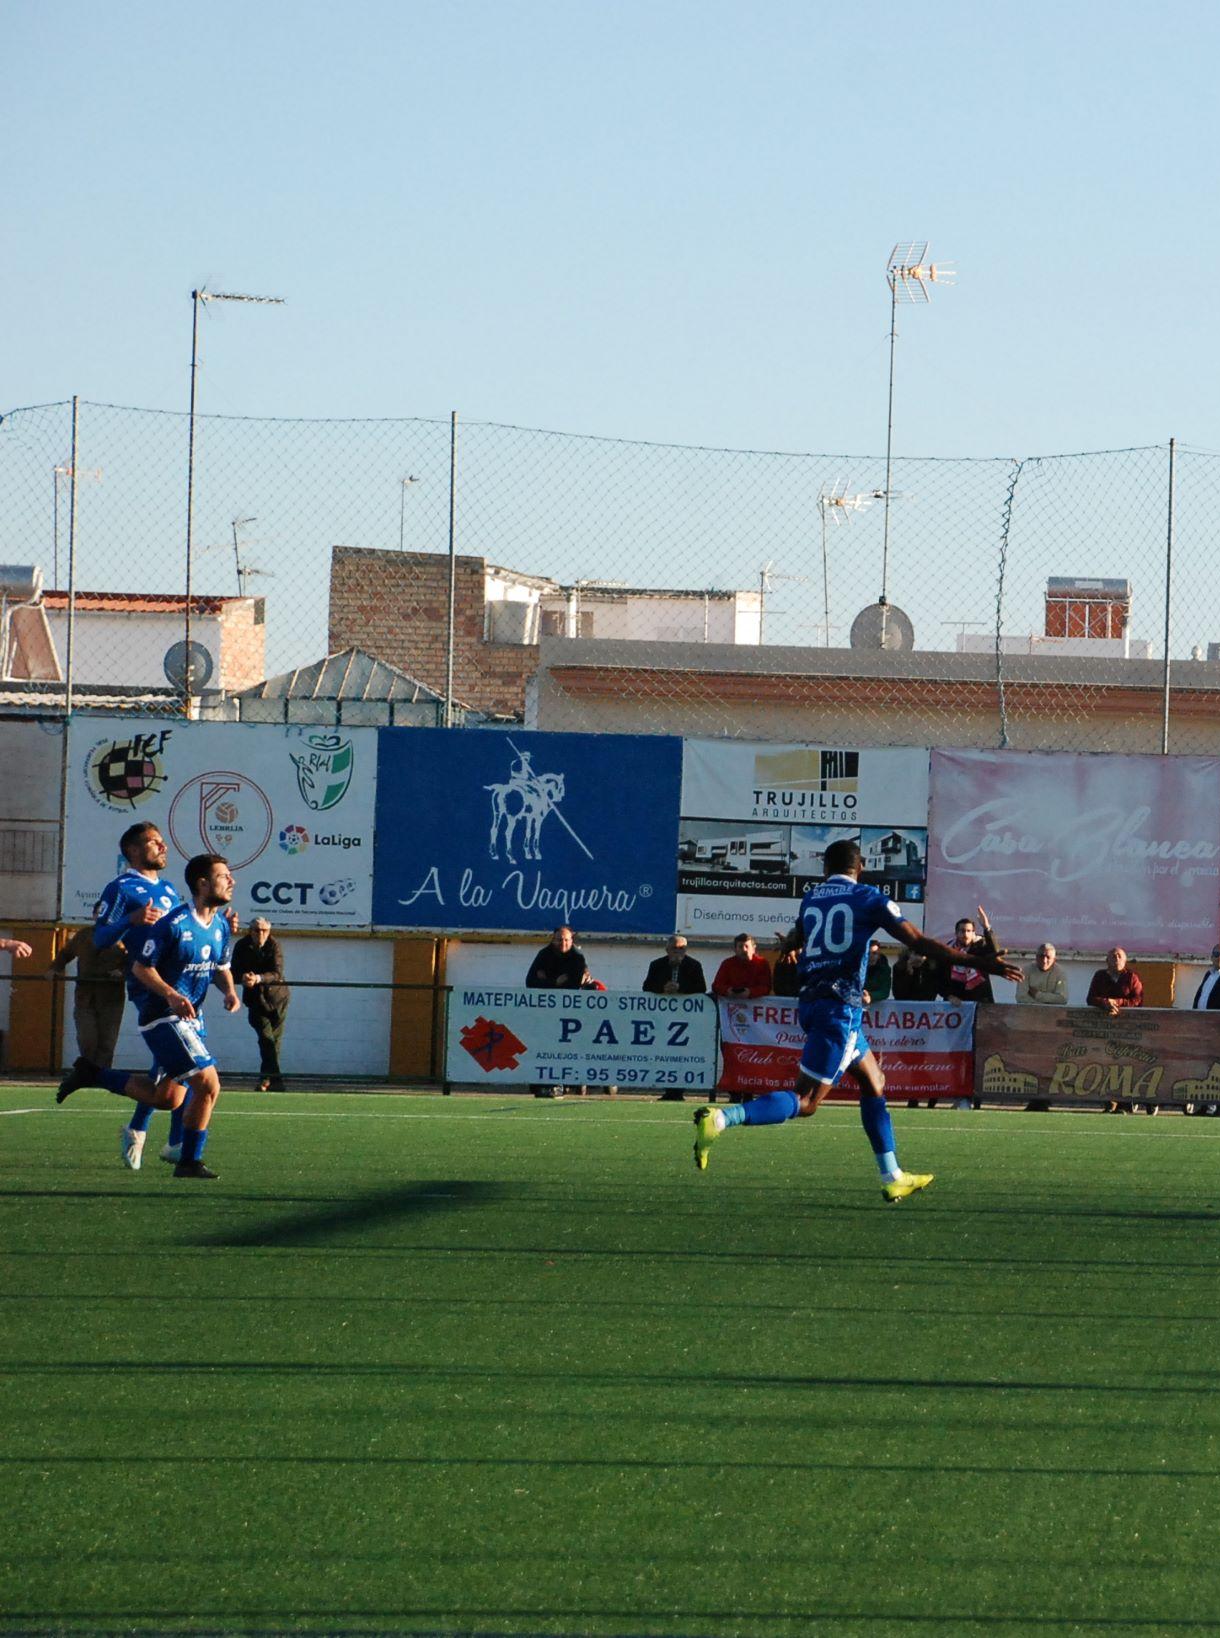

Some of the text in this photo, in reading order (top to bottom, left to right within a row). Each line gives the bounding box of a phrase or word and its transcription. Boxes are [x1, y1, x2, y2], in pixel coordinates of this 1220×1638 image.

[753, 790, 857, 809] TRUJILLO
[752, 808, 857, 821] ARQUITECTOS
[314, 833, 362, 849] LaLiga
[250, 881, 314, 905] CCT
[398, 867, 445, 905] A
[460, 868, 492, 906] la
[682, 877, 787, 891] trujilloarquitectos.com
[693, 908, 755, 922] Diseñamos
[804, 903, 854, 957] 20
[562, 995, 582, 1009] DE
[559, 1018, 690, 1047] PAEZ
[536, 1053, 578, 1061] AZULEJOS
[585, 1053, 649, 1062] SANEAMIENTOS
[655, 1056, 706, 1064] PAVIMENTOS
[536, 1066, 705, 1084] TLF: 95 597 25 01
[1049, 1062, 1164, 1098] ROMA
